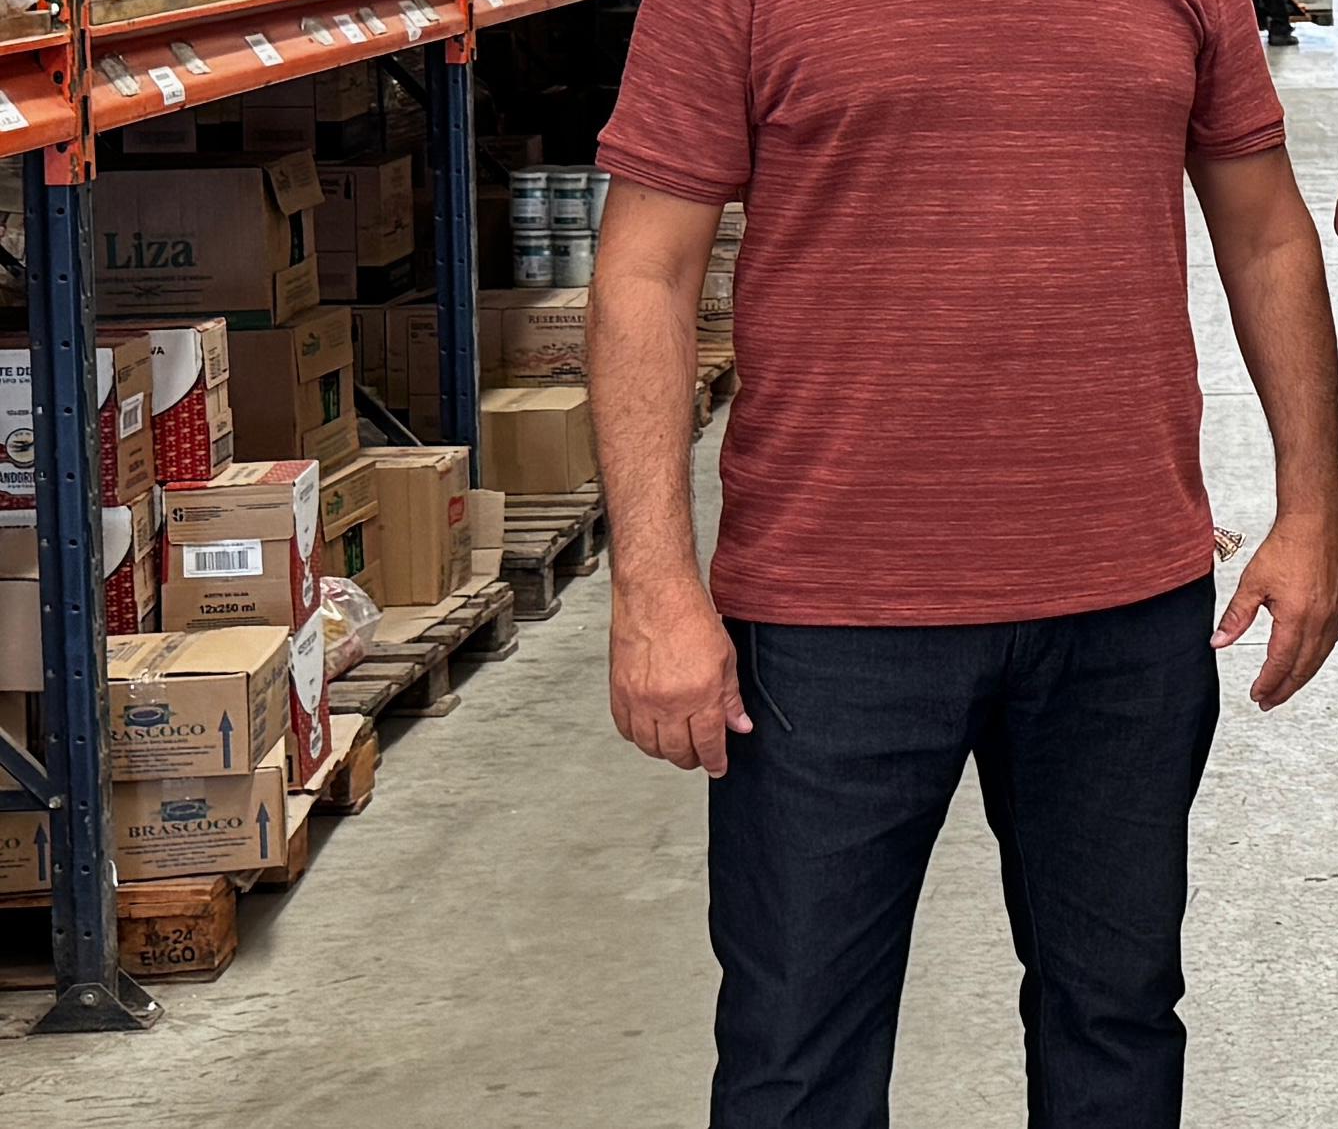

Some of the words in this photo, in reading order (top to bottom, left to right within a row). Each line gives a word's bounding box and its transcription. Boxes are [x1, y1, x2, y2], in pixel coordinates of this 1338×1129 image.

[104, 231, 197, 269] Liza
[241, 602, 256, 613] ml
[110, 724, 206, 742] RASCOCO
[128, 817, 243, 839] BRASCOCO
